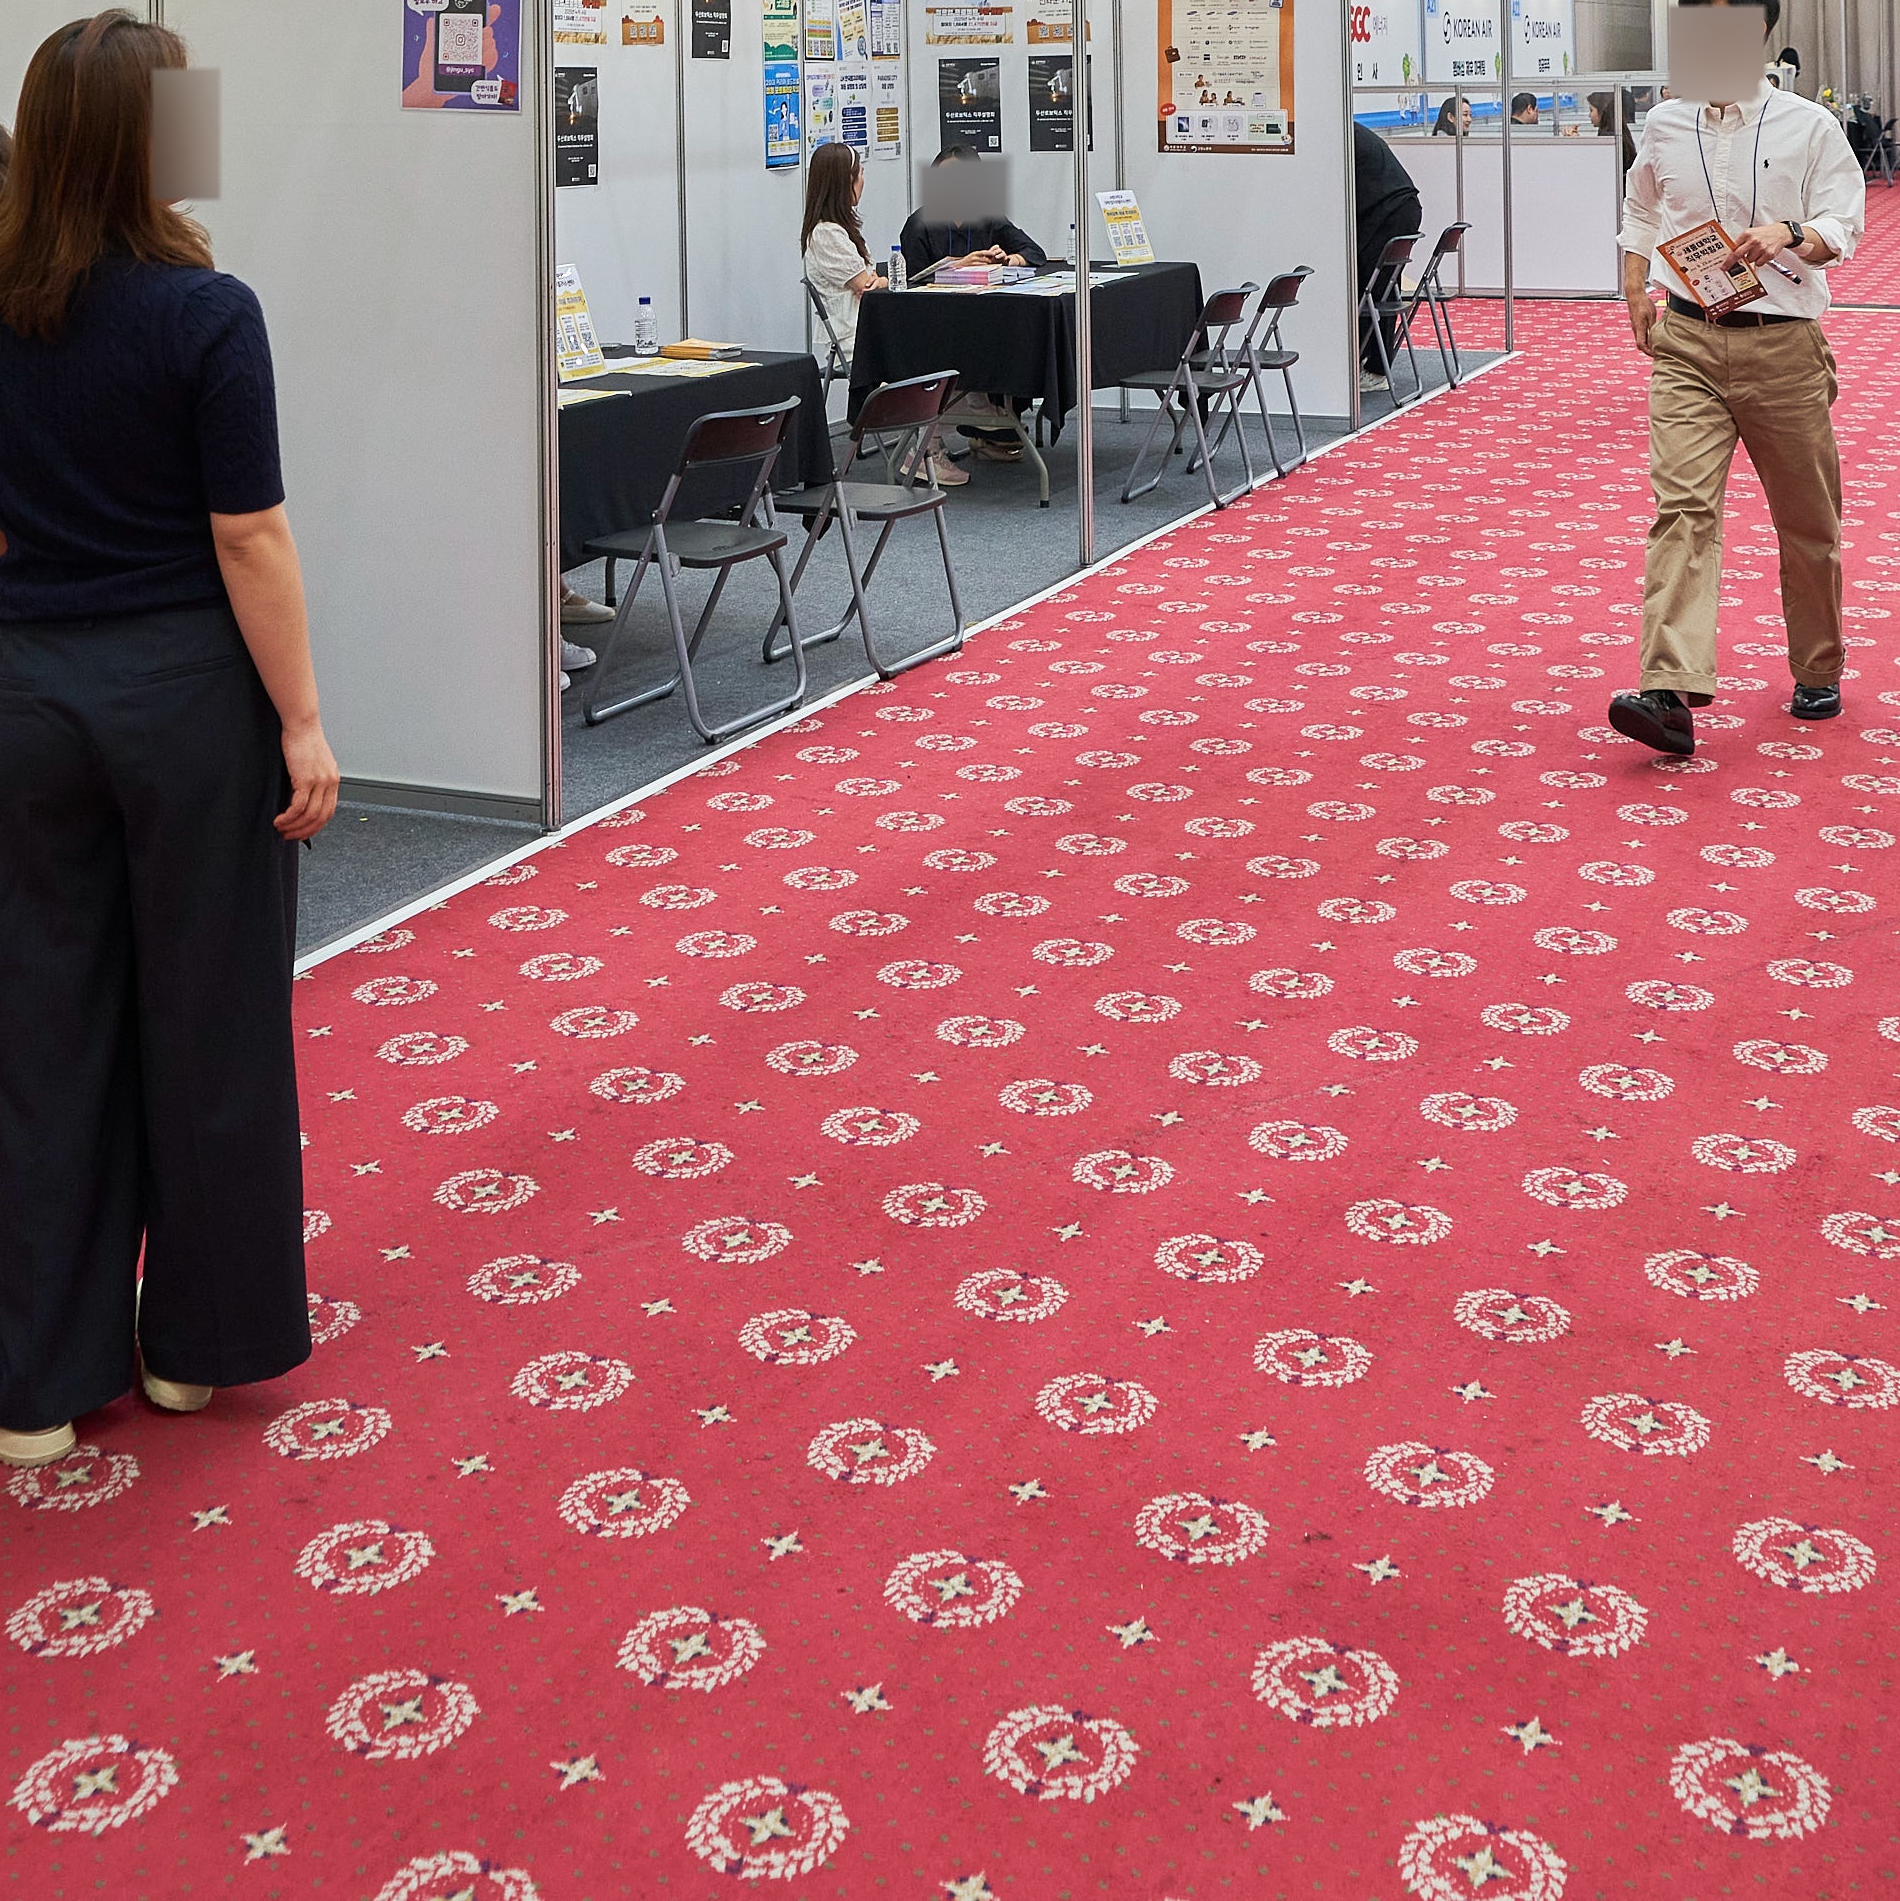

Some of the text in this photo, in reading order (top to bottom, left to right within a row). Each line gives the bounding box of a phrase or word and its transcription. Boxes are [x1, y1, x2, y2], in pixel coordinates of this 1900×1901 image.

[1373, 16, 1388, 35] 에너지
[1453, 19, 1493, 38] KOREAN AIR
[1532, 22, 1561, 38] KOREAN AIR
[1686, 241, 1724, 263] 직무박람회
